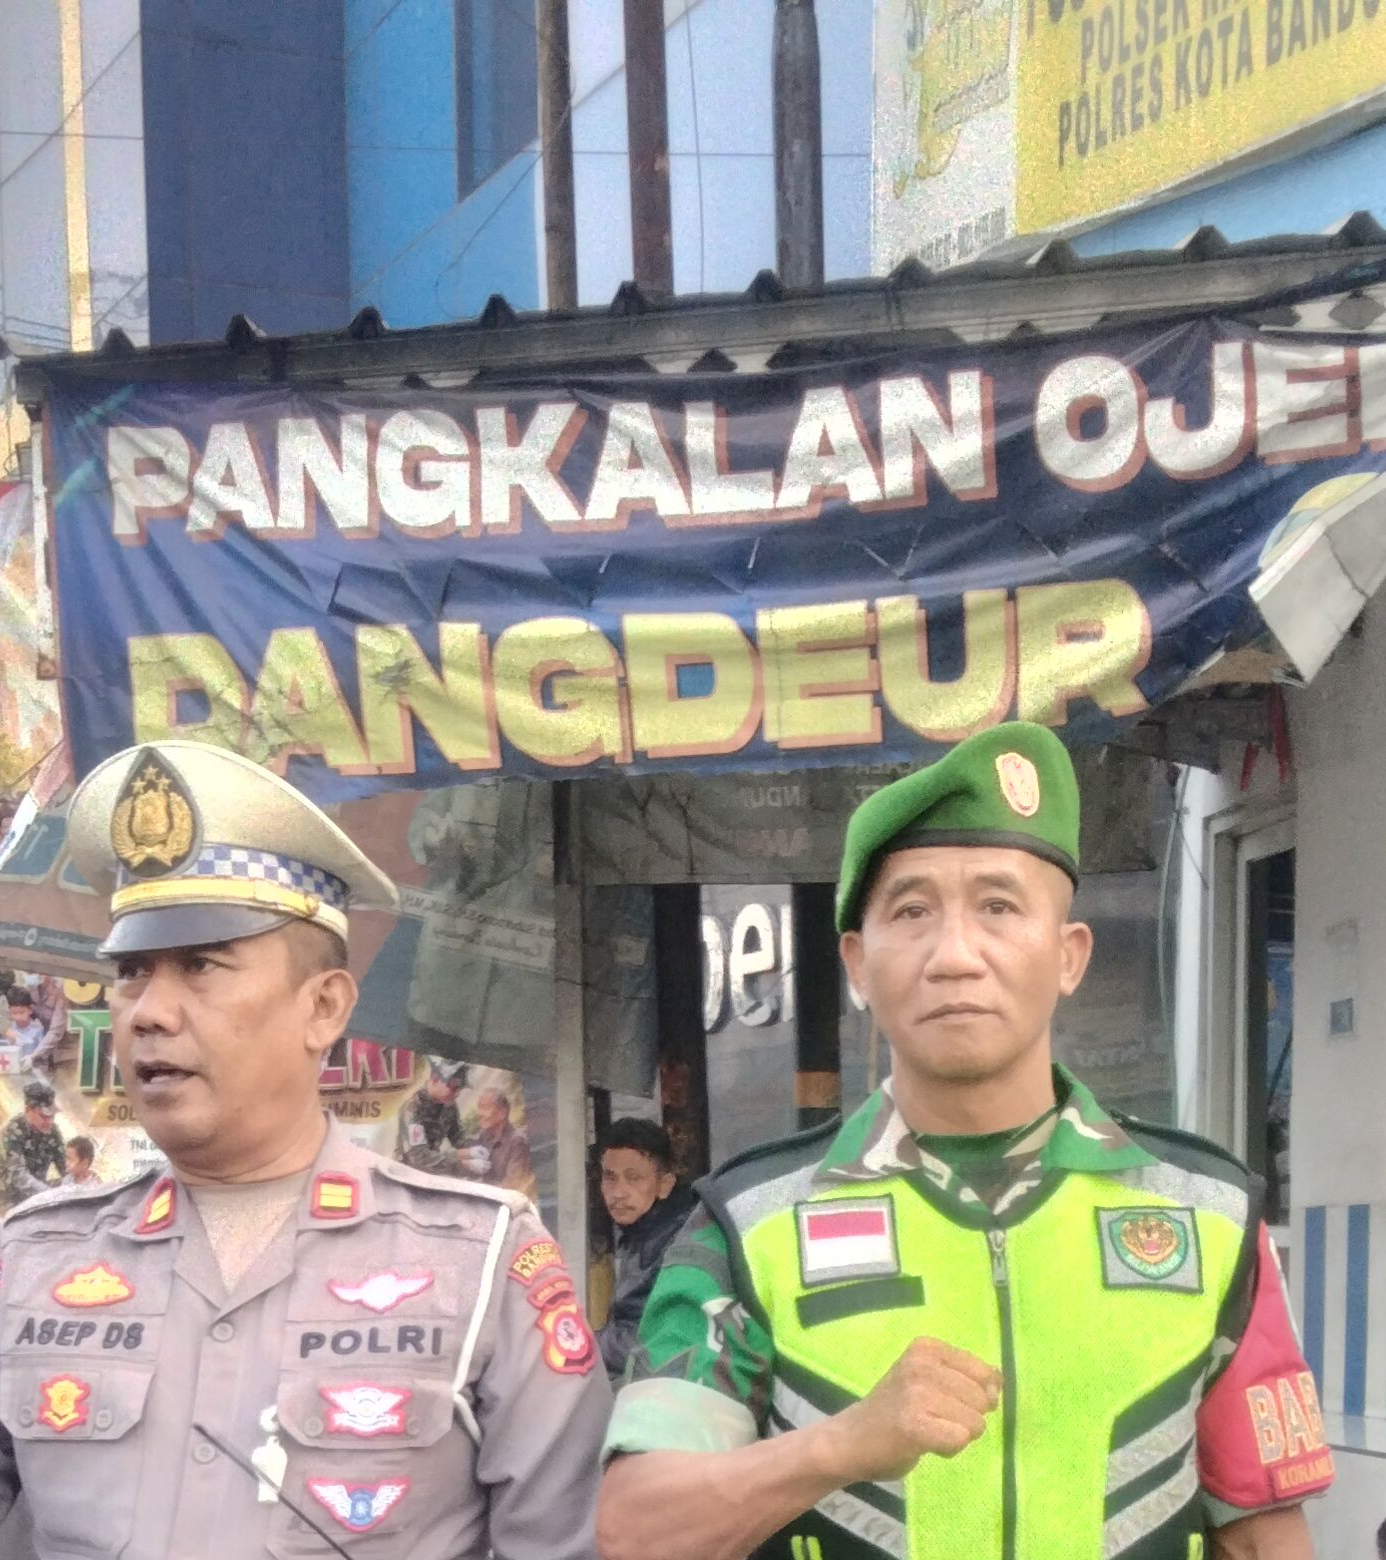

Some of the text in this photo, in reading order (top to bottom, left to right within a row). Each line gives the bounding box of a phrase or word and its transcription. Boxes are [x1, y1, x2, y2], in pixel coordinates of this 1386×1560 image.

[1059, 54, 1163, 169] POLRES
[1174, 6, 1254, 111] KOTA
[107, 370, 998, 545] PANGKALAN
[15, 1317, 97, 1347] ASEP
[299, 1325, 443, 1358] POLRI
